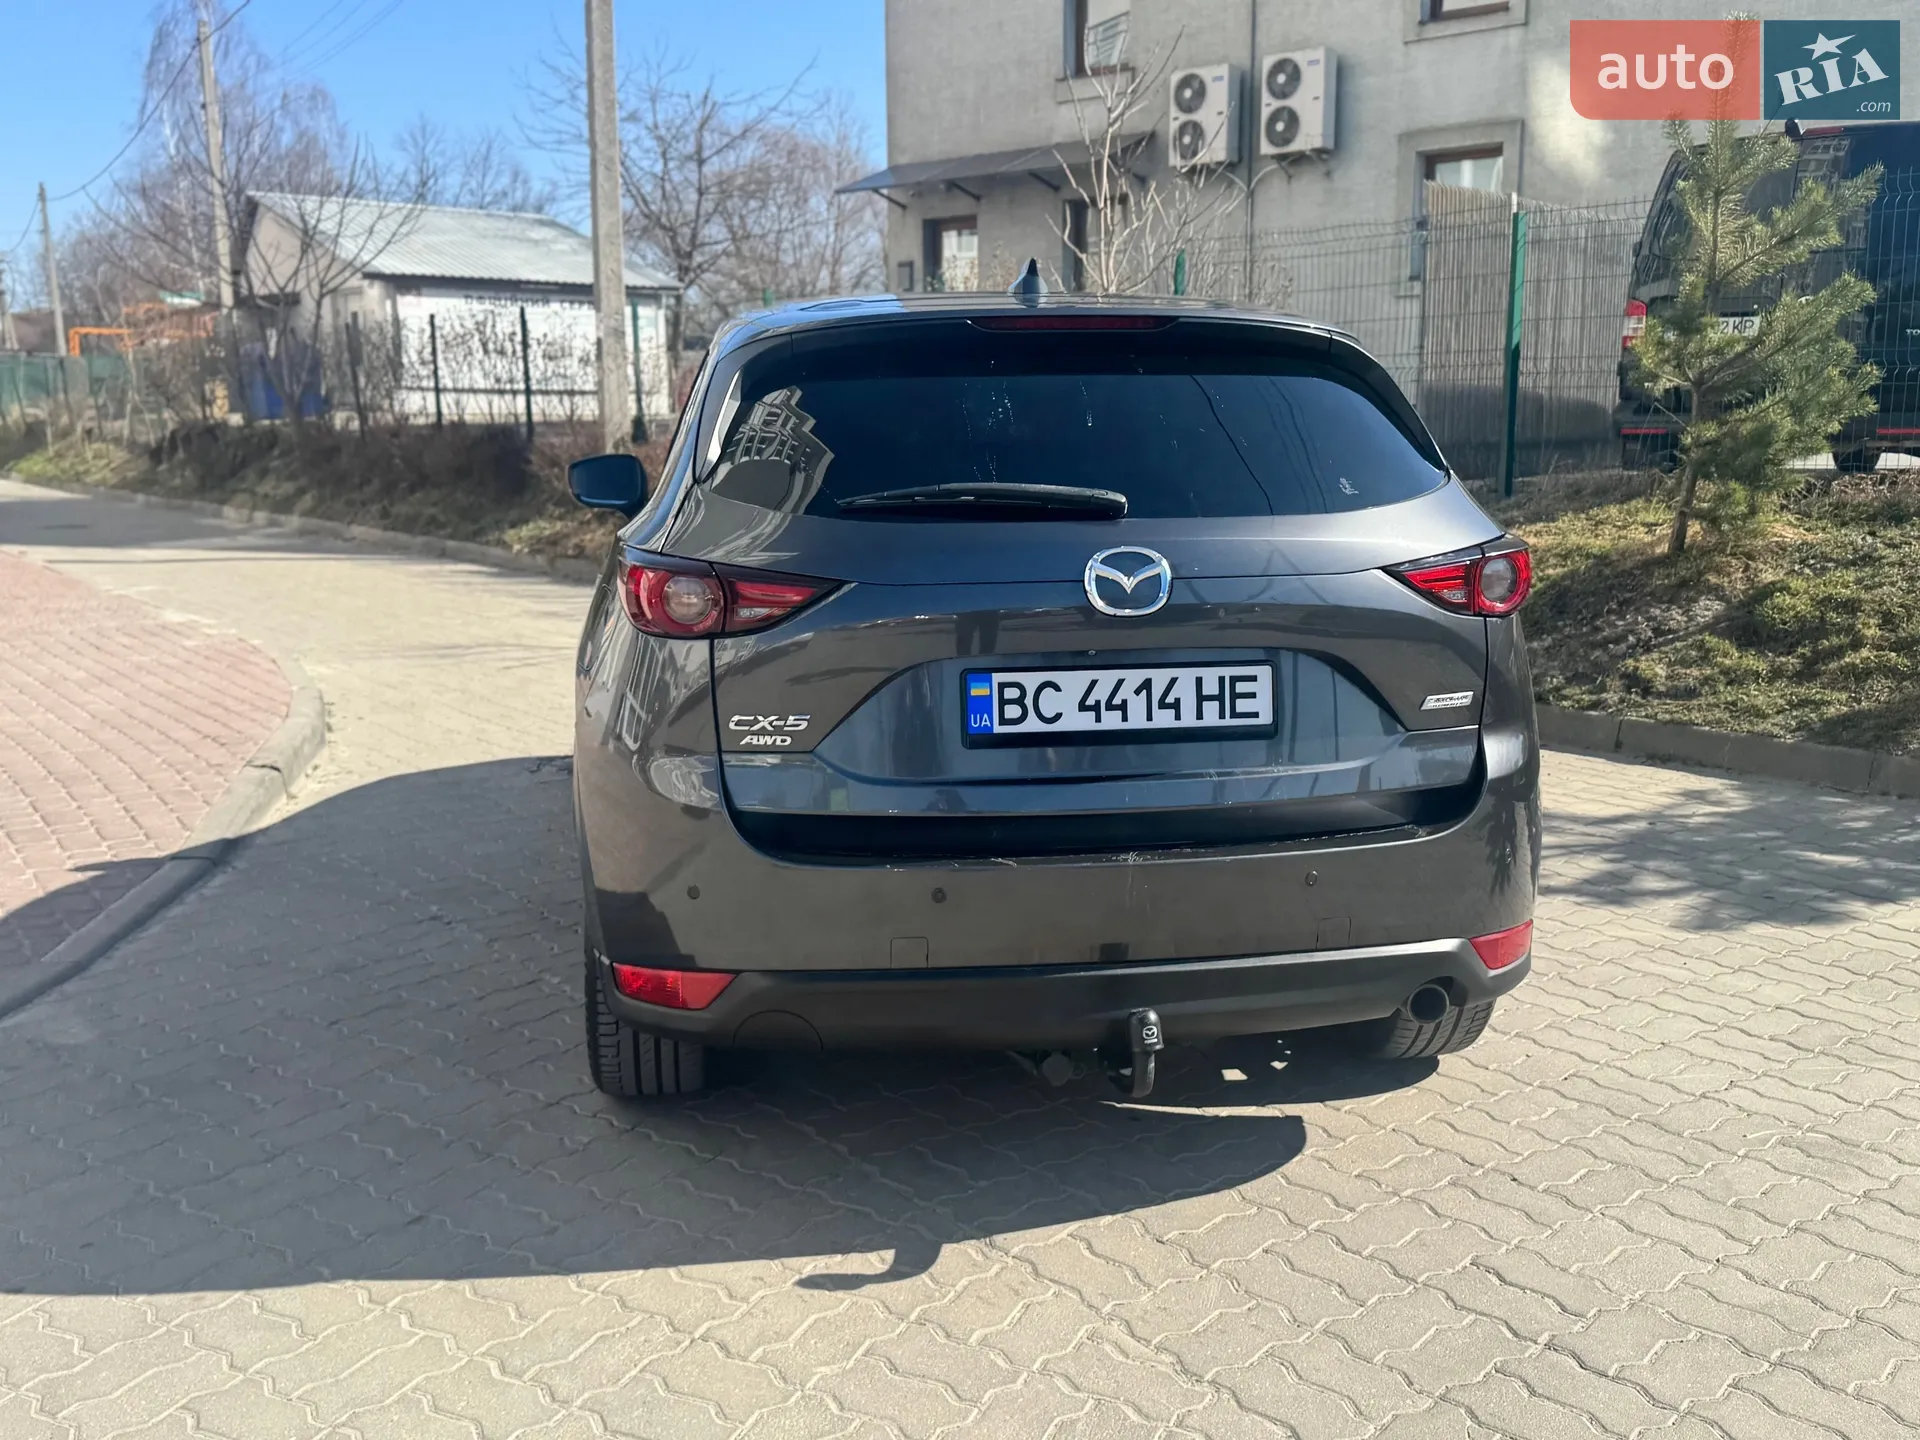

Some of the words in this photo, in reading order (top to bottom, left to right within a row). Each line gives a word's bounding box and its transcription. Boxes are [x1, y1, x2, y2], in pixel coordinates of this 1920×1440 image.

[997, 680, 1064, 727] BC
[1077, 676, 1182, 724] 4414
[1195, 674, 1260, 721] HE
[728, 714, 811, 731] CX-5
[970, 713, 991, 728] UA
[739, 734, 792, 746] AWD
